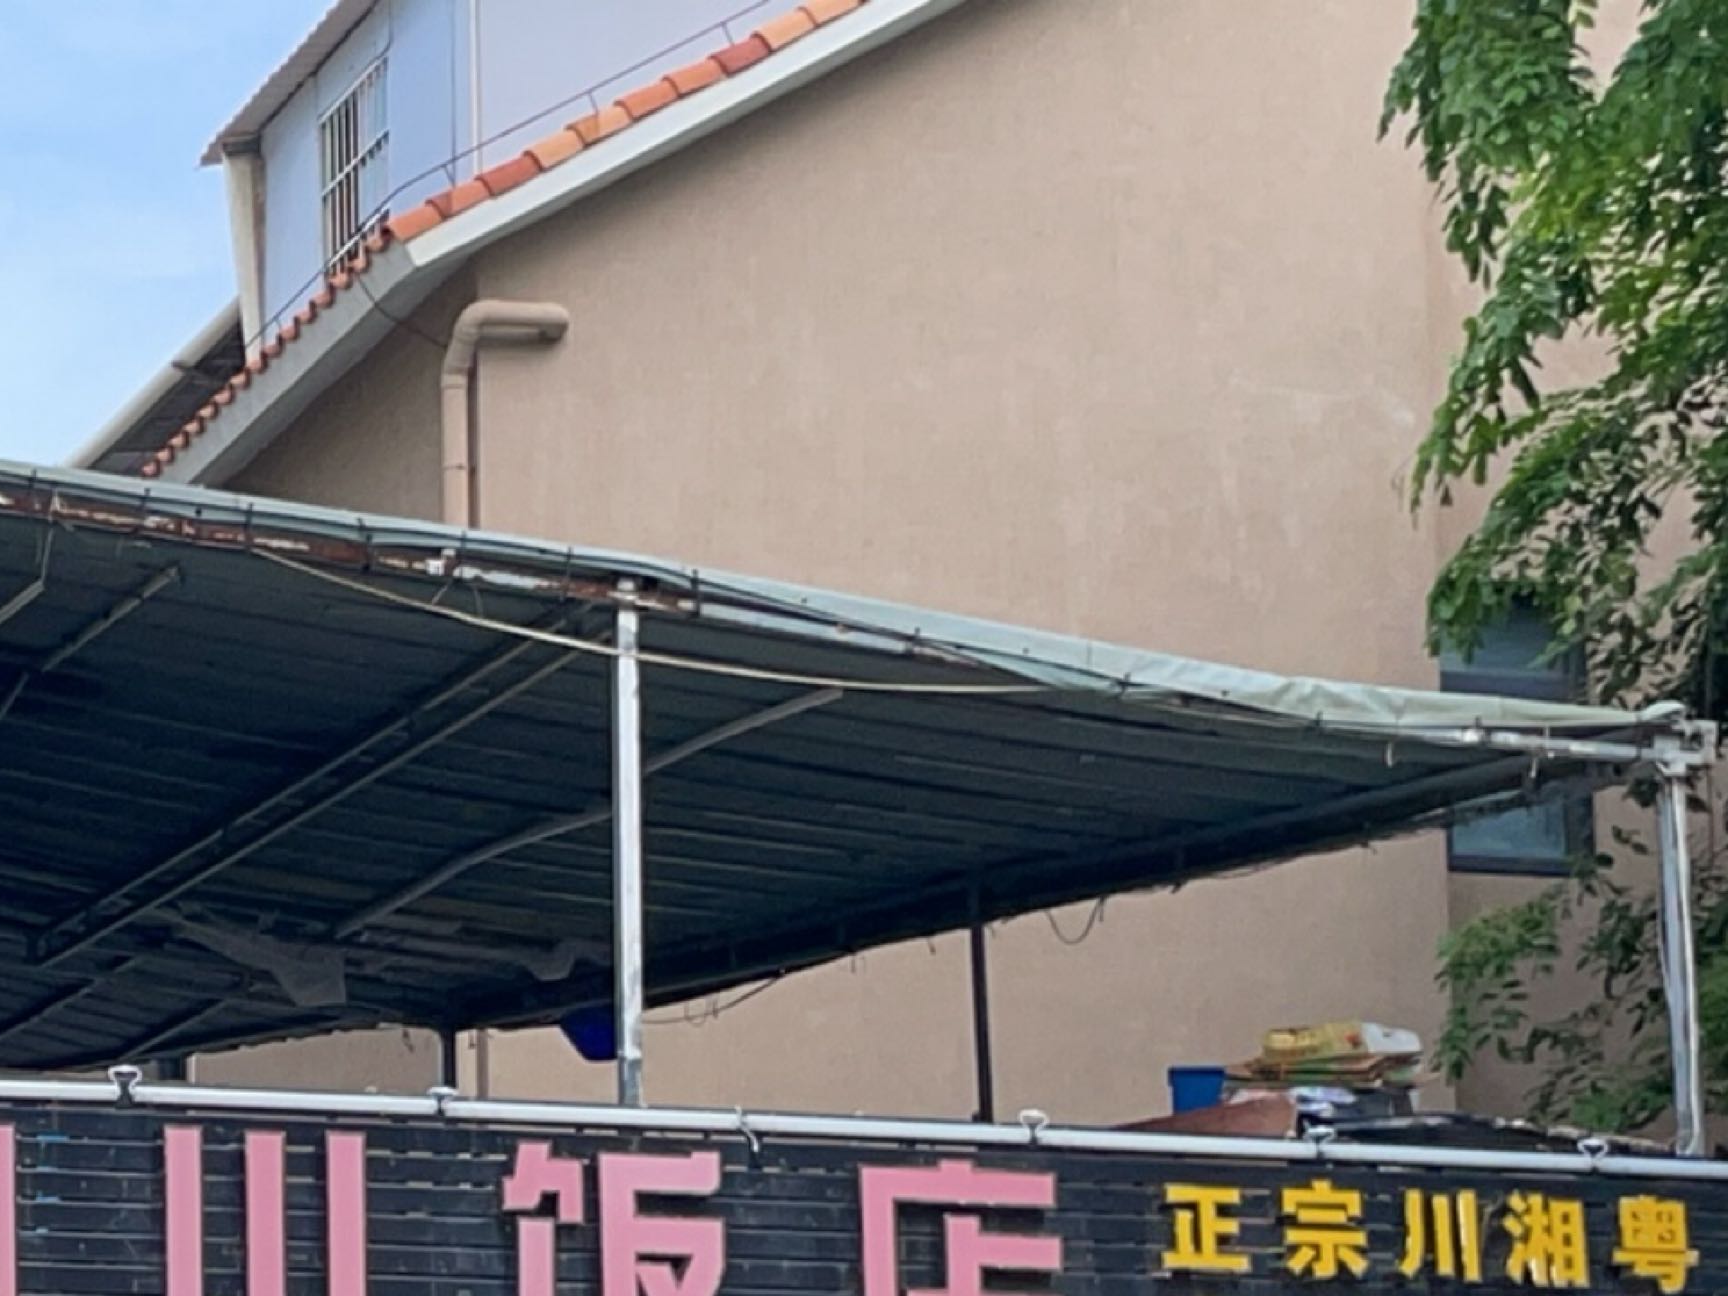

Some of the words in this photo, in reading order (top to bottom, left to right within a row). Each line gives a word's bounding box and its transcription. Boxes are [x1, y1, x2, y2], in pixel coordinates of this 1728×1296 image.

[1160, 1179, 1701, 1296] 正宗川湘粤
